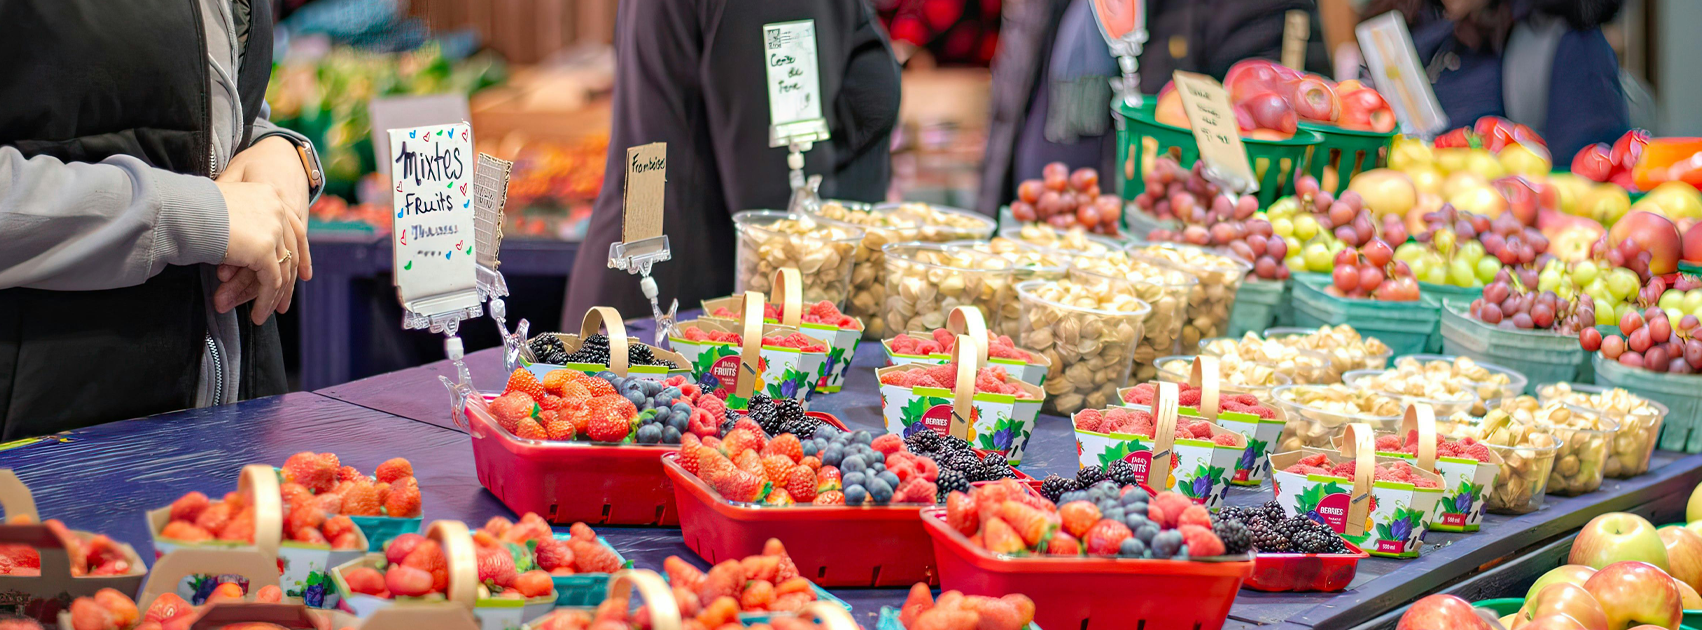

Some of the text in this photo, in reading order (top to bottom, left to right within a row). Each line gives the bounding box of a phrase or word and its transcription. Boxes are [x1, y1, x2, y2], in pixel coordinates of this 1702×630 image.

[714, 366, 737, 377] FRUITS
[925, 417, 948, 426] BERRIES
[1320, 506, 1343, 516] BERRIES
